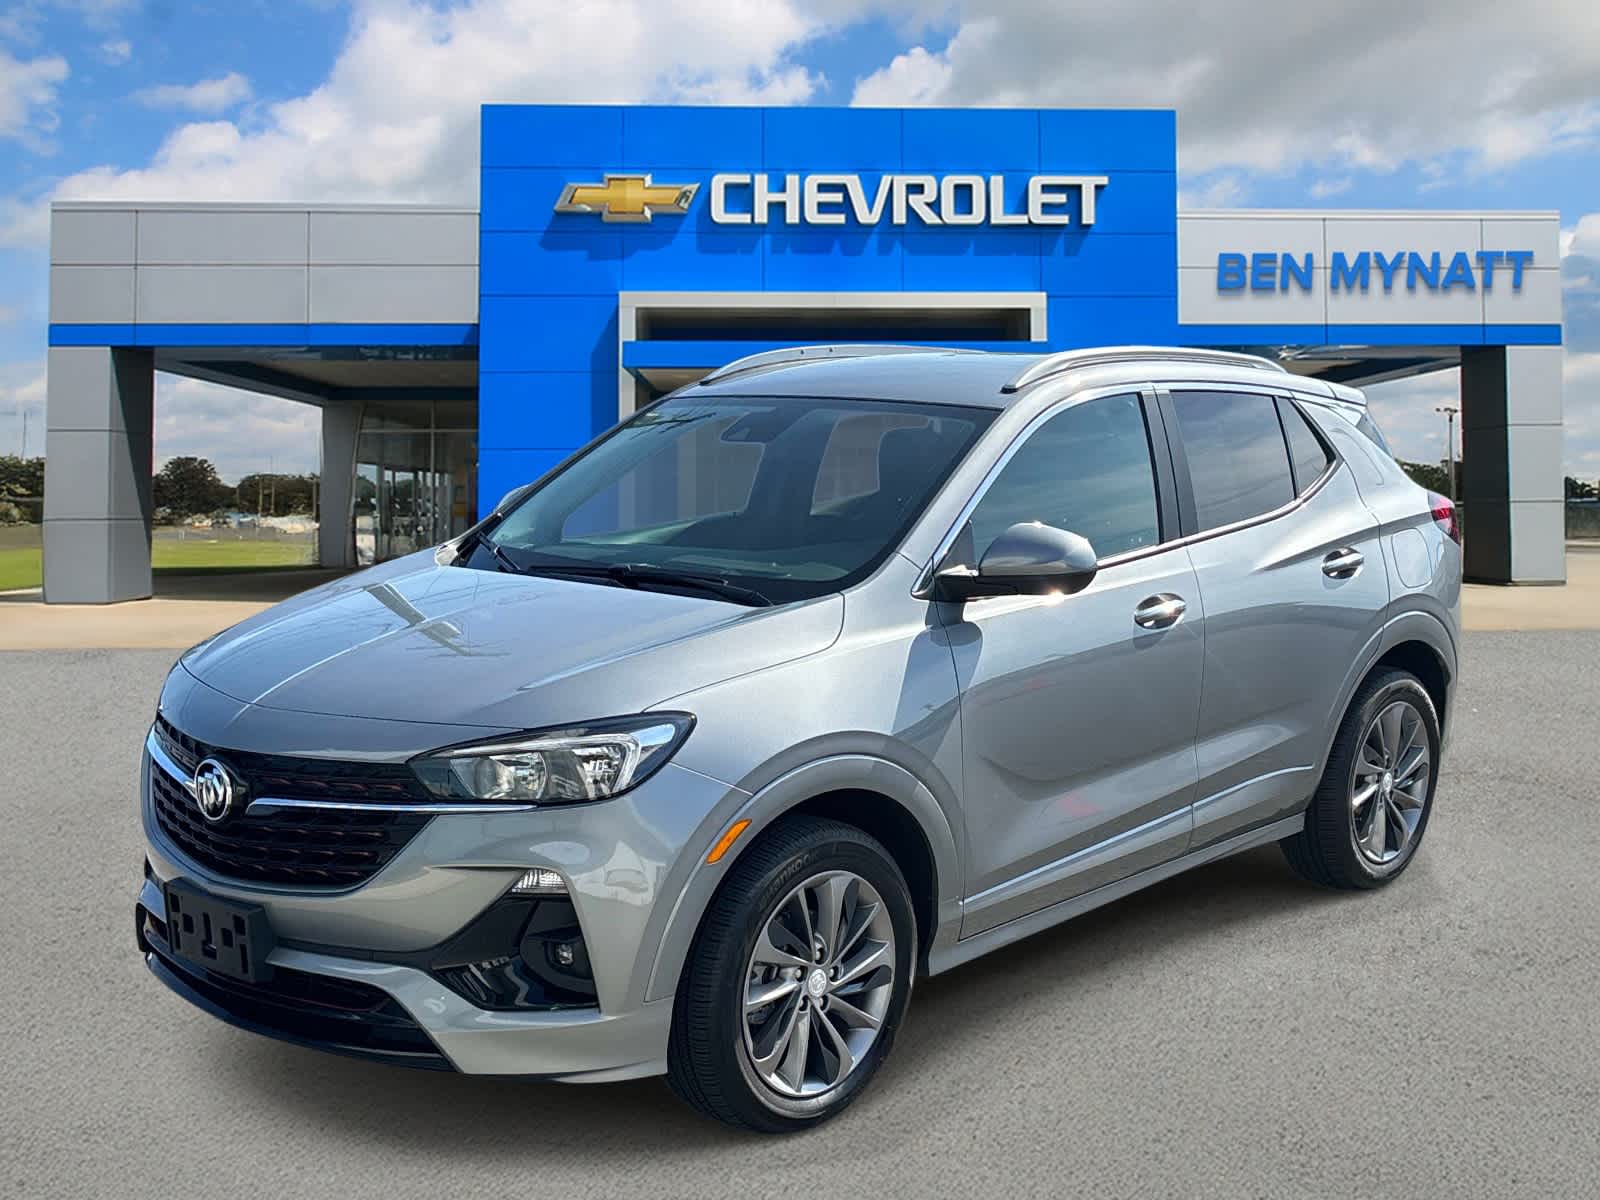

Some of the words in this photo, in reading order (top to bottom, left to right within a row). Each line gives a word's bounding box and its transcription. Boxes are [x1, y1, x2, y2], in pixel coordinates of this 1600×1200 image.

[711, 173, 1109, 225] CHEVROLET
[1217, 252, 1313, 290] BEN
[1330, 250, 1534, 290] MYNATT
